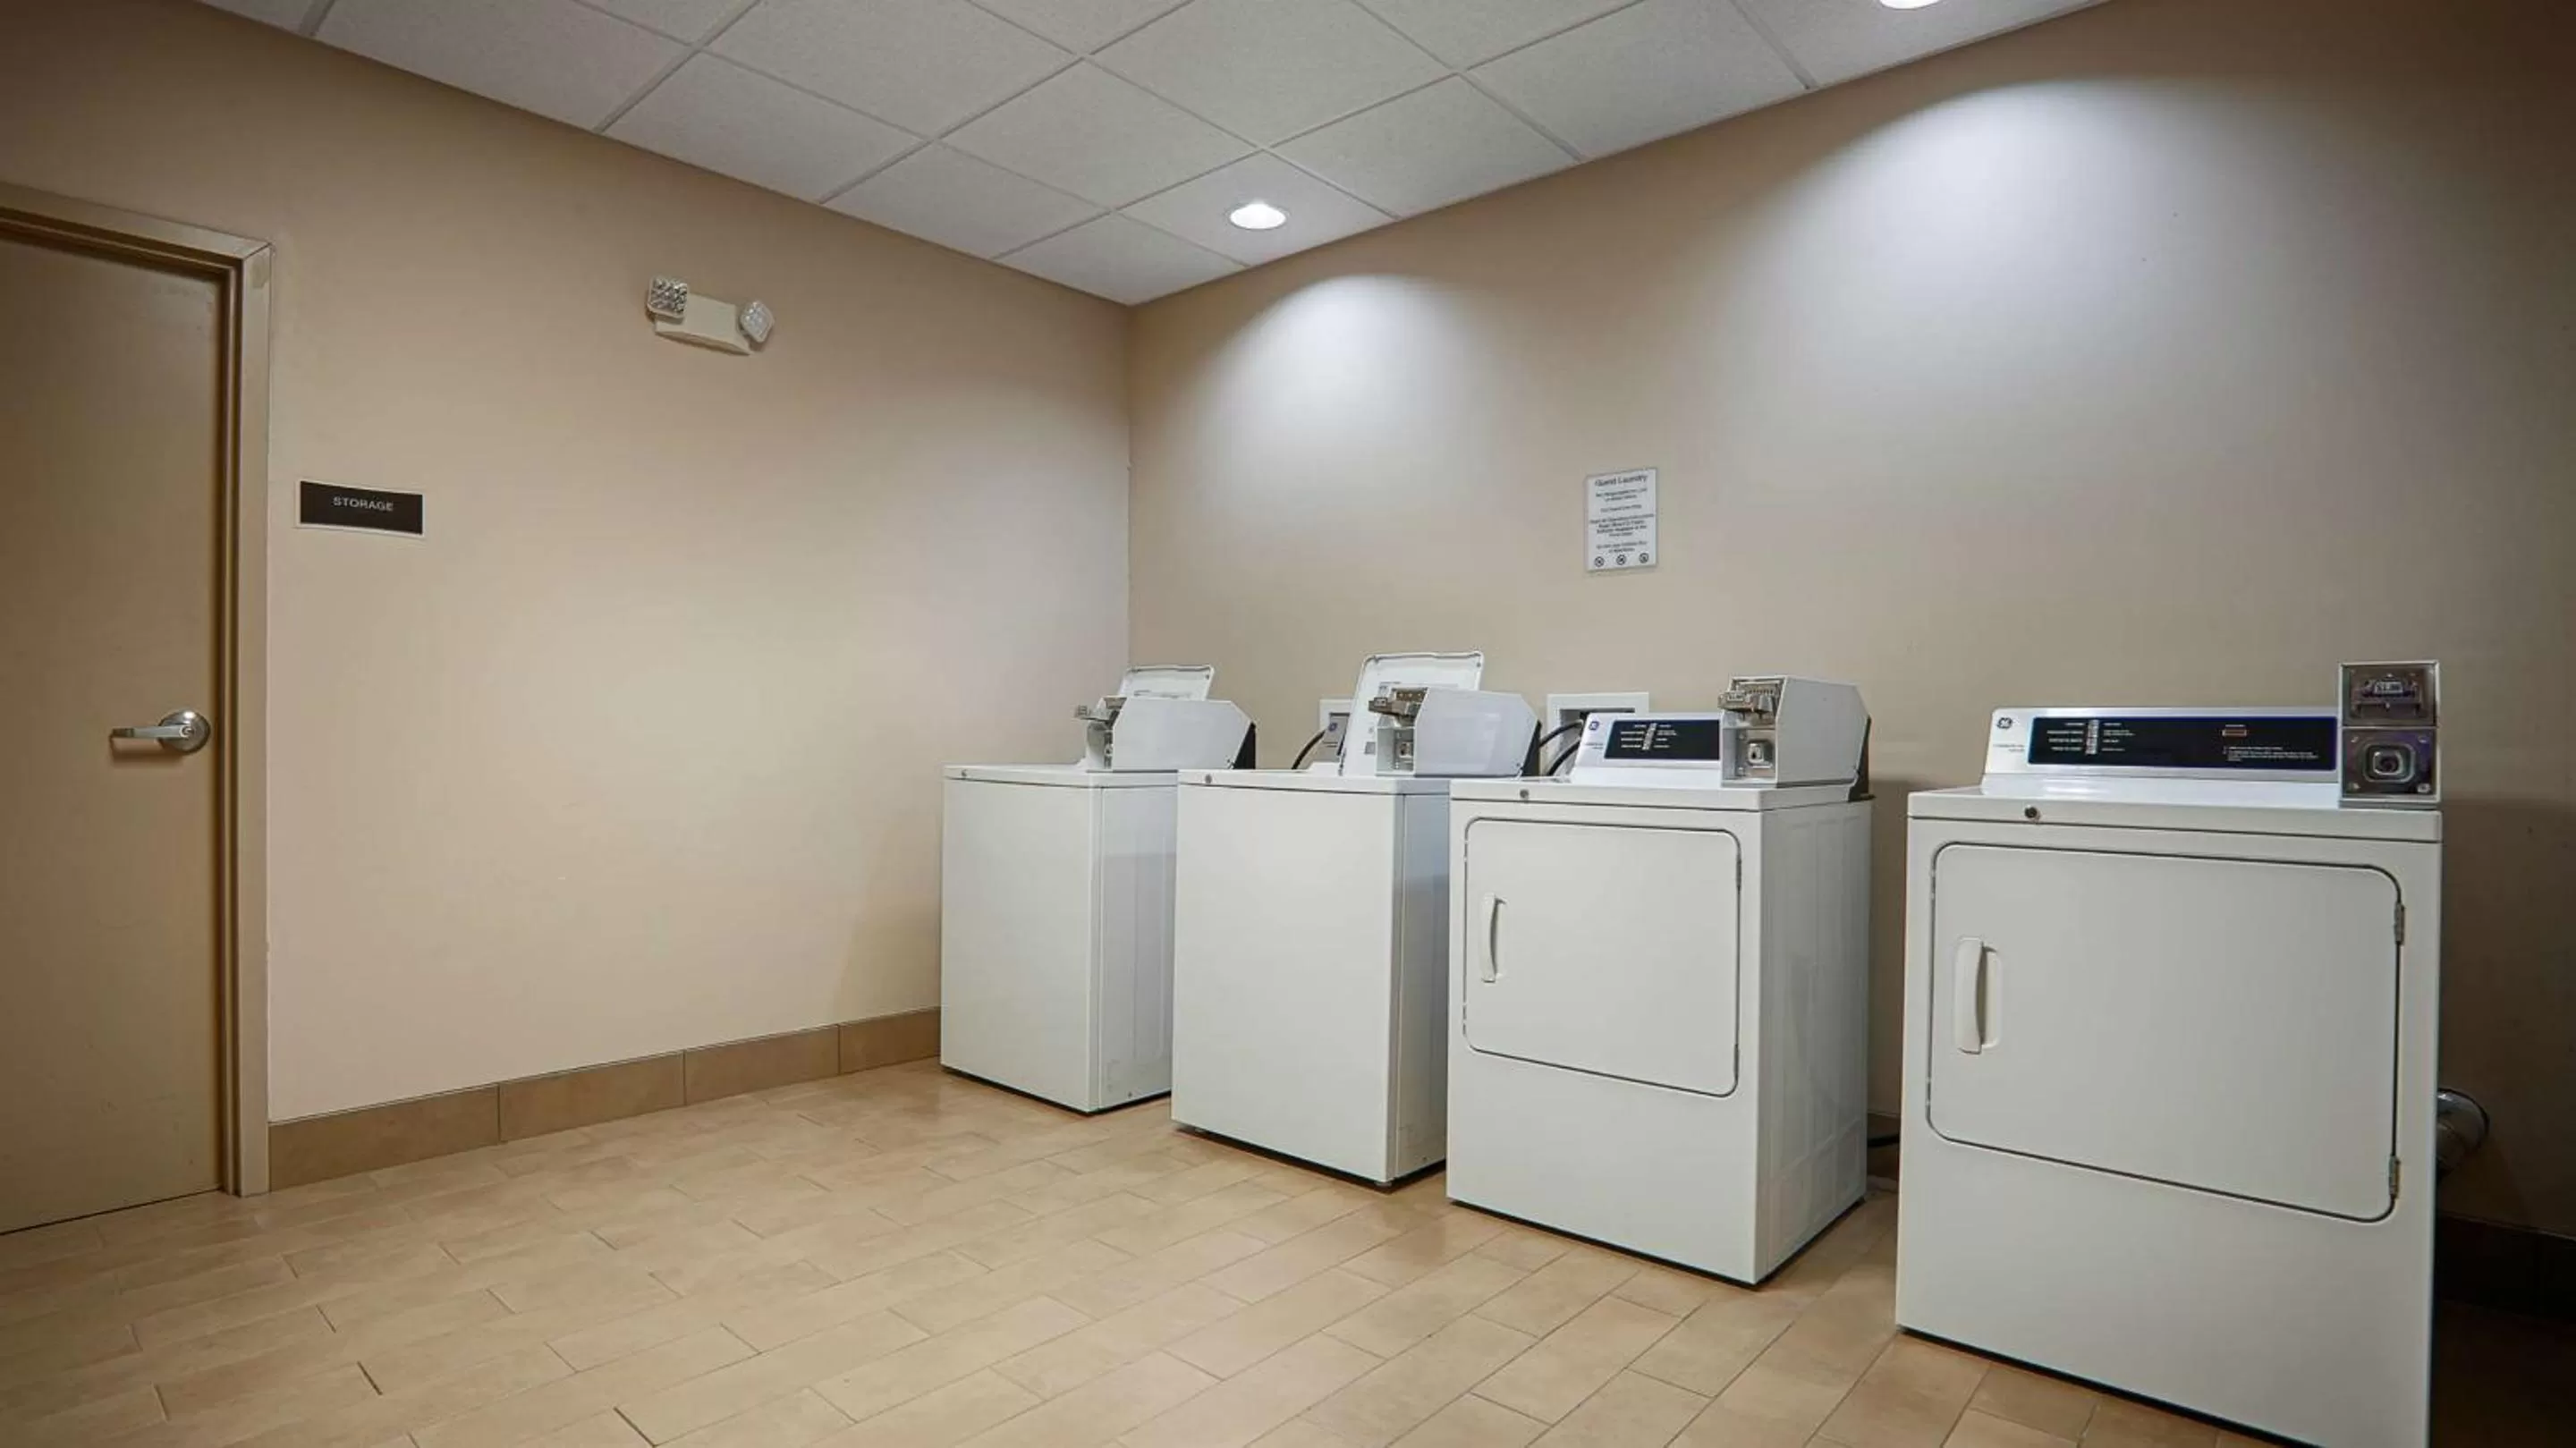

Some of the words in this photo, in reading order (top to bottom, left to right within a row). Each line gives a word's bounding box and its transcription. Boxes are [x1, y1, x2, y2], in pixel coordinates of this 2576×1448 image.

[1595, 477, 1616, 487] Guest
[1618, 474, 1648, 485] Laundry
[333, 496, 394, 511] STORAGE
